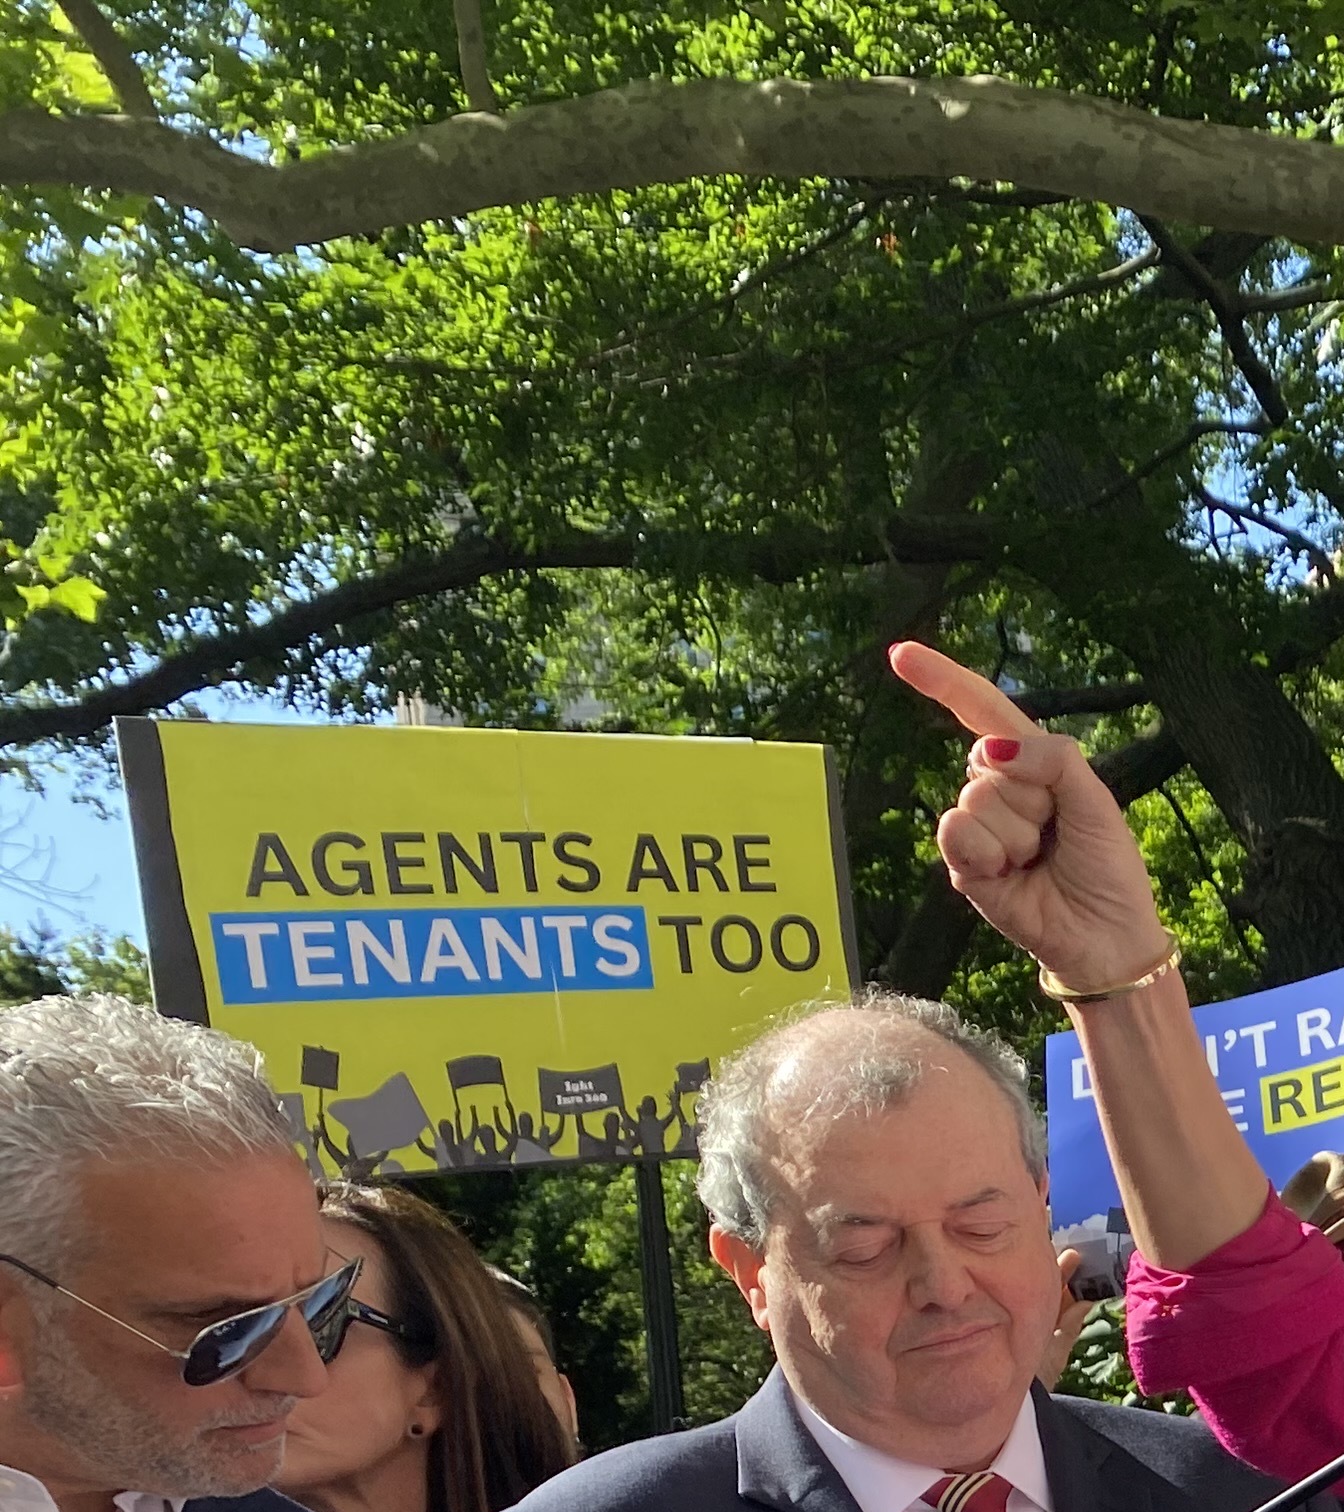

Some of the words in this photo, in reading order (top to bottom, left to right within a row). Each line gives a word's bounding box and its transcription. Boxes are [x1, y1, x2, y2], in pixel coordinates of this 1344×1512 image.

[245, 831, 601, 898] AGENTS
[626, 833, 778, 893] ARE
[222, 913, 641, 989] TENANTS
[658, 912, 822, 975] TOO
